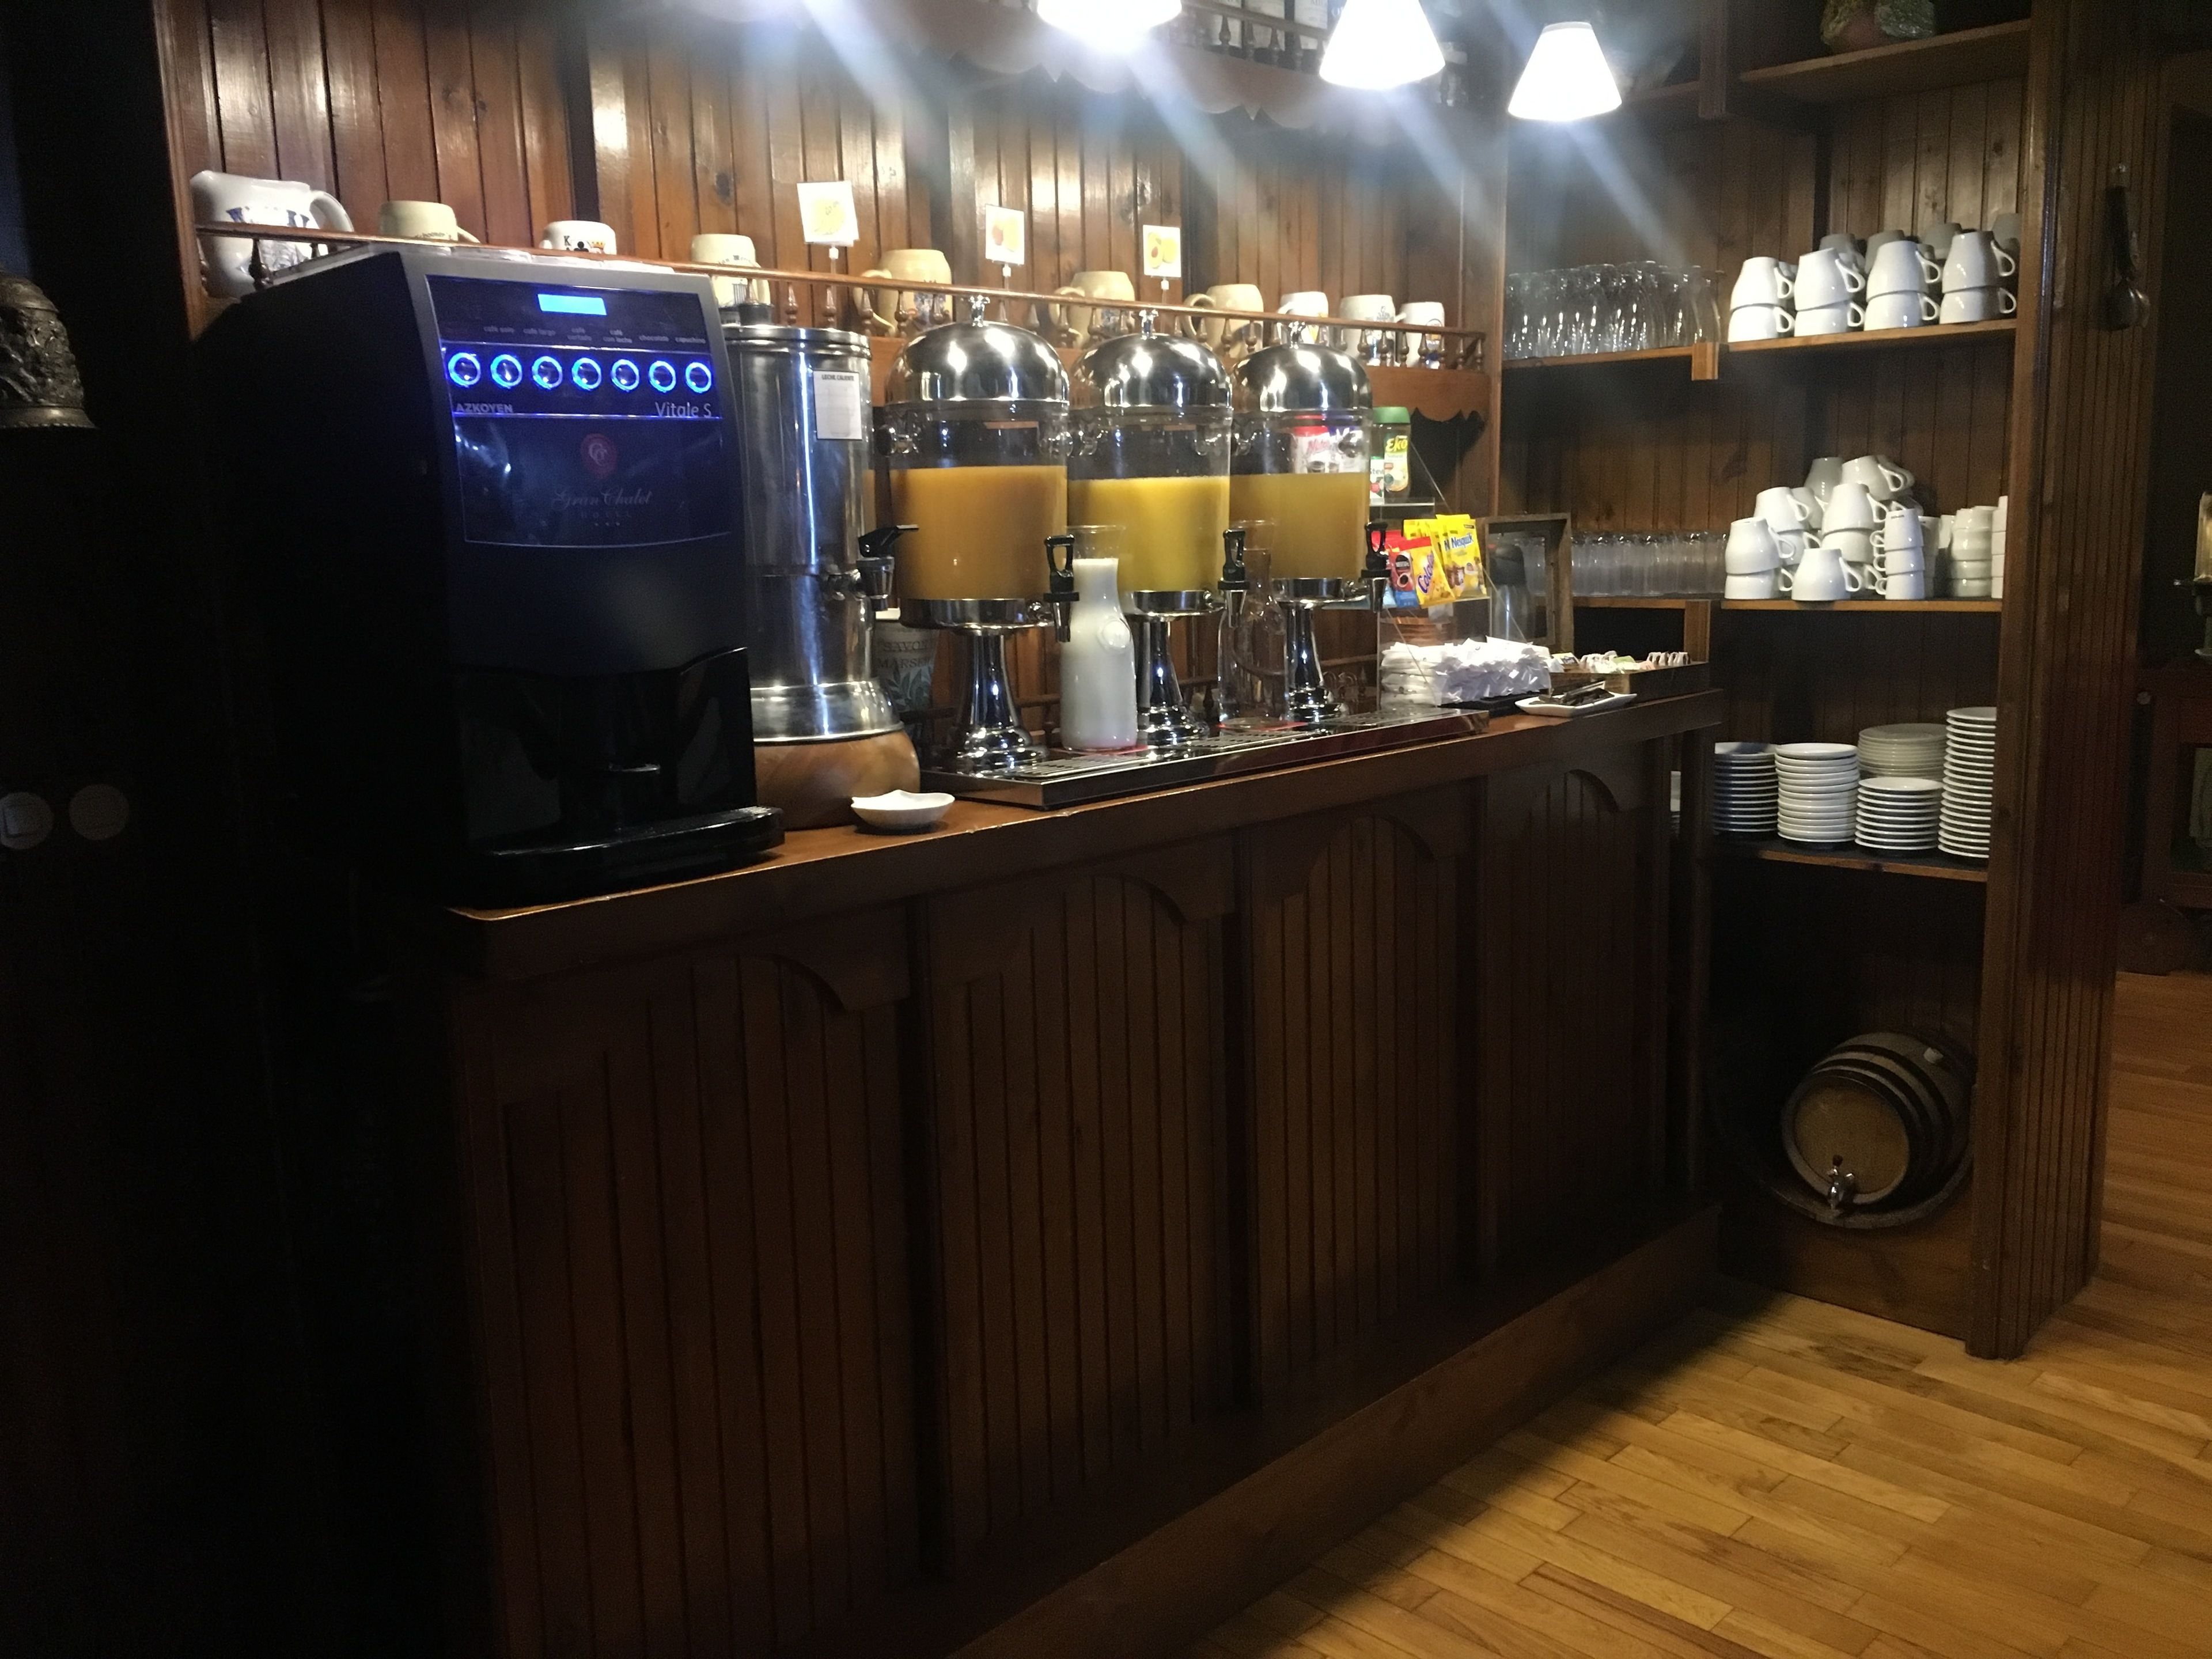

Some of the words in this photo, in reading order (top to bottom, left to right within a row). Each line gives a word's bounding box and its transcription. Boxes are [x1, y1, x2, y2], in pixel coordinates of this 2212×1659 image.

[456, 403, 513, 414] AZKOYEN
[656, 402, 699, 418] Vitale
[703, 403, 712, 418] S
[1450, 532, 1474, 548] Nesquik
